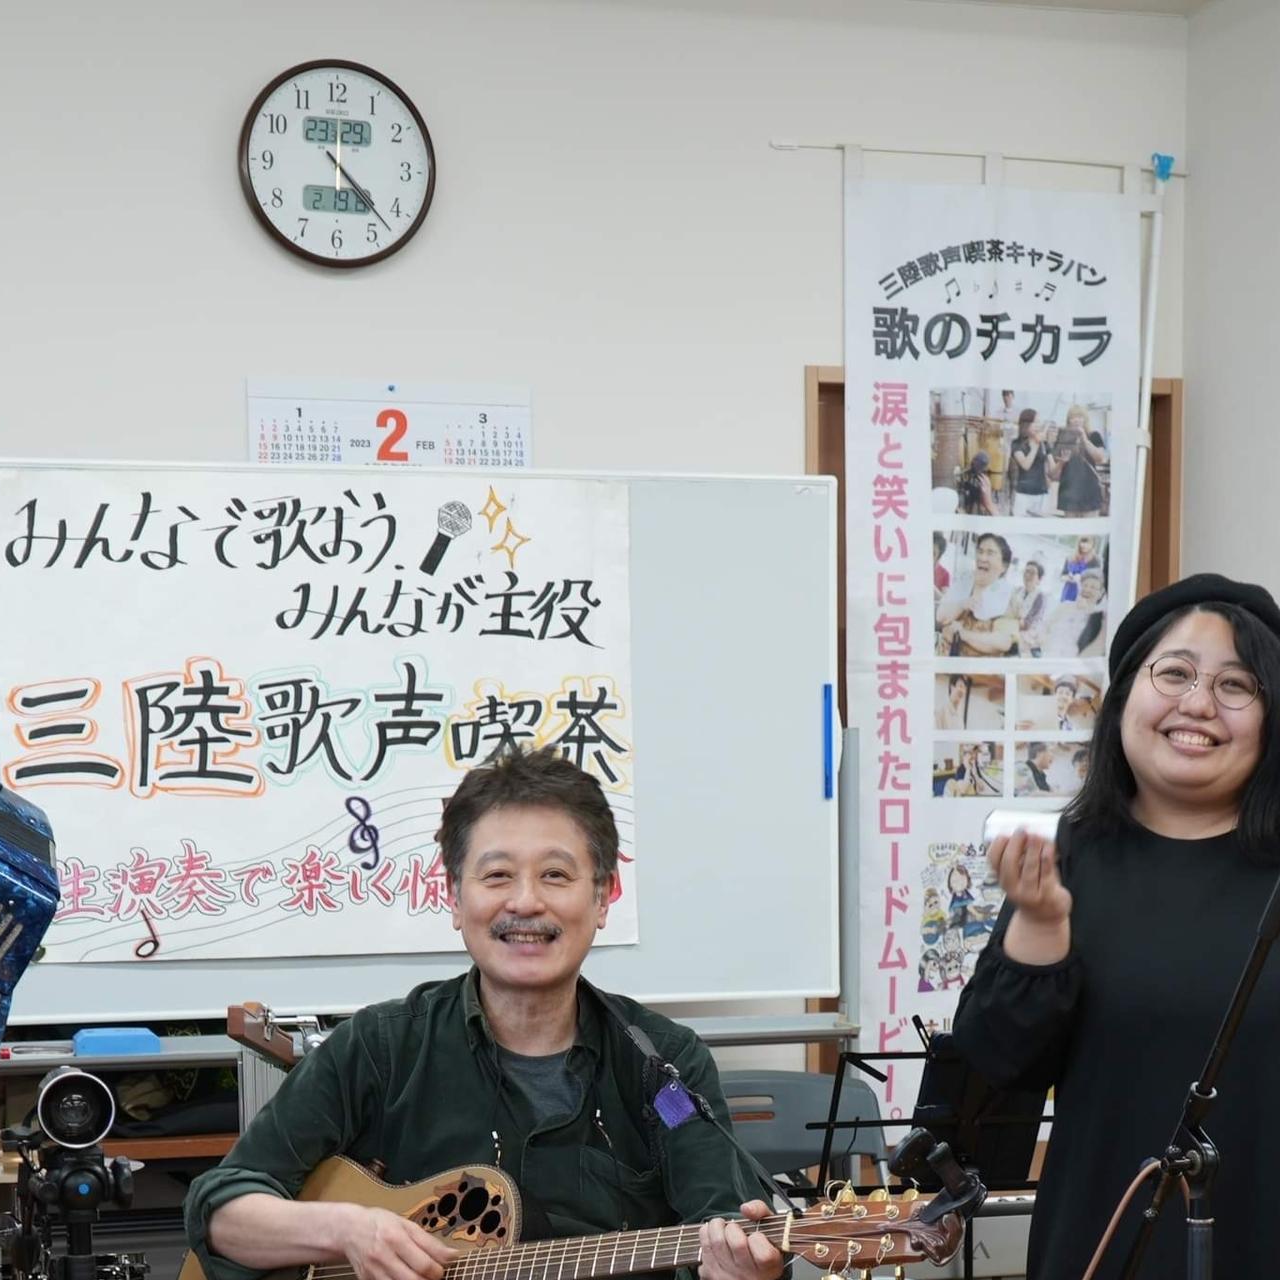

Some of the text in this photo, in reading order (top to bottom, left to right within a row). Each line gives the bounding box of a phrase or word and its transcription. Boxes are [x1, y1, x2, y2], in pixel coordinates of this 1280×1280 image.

[295, 89, 310, 110] 11
[327, 82, 348, 103] 12
[369, 96, 376, 115] 1
[268, 114, 287, 135] 10
[391, 123, 402, 143] 2
[262, 150, 274, 170] 9
[400, 161, 412, 182] 3
[271, 187, 283, 208] 8
[389, 197, 402, 218] 4
[297, 218, 309, 237] 7
[366, 223, 378, 243] 5
[331, 229, 343, 249] 6
[878, 239, 1108, 301] 三陸歌声喫茶キャラバン
[872, 306, 1113, 367] 歌のチカラ
[296, 407, 302, 418] 1
[479, 413, 488, 424] 3
[349, 439, 371, 448] 2023
[375, 408, 409, 462] 2
[415, 440, 435, 450] FEB
[275, 571, 605, 649] みんなが主役
[11, 656, 631, 789] 三陸歌声喫茶
